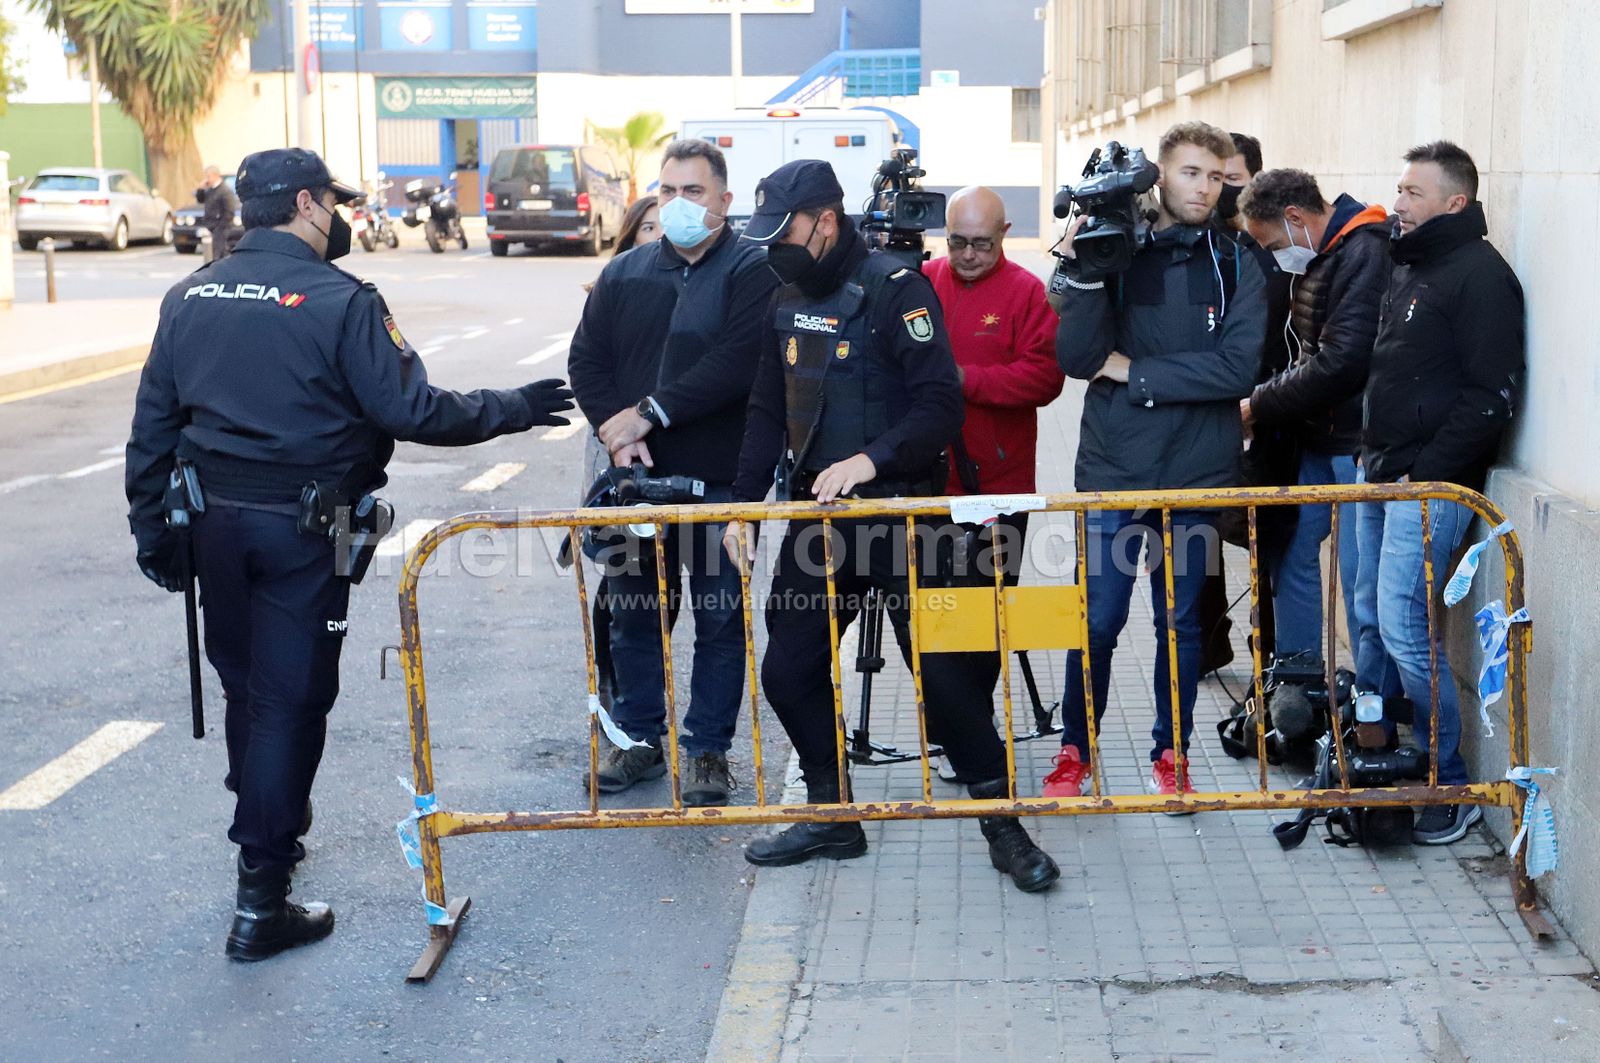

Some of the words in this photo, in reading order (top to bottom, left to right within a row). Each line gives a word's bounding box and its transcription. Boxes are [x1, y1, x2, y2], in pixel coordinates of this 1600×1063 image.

[184, 283, 281, 302] POLICIA
[794, 313, 827, 325] POLICIA
[793, 320, 837, 333] NACIONAL
[327, 620, 348, 631] CNP
